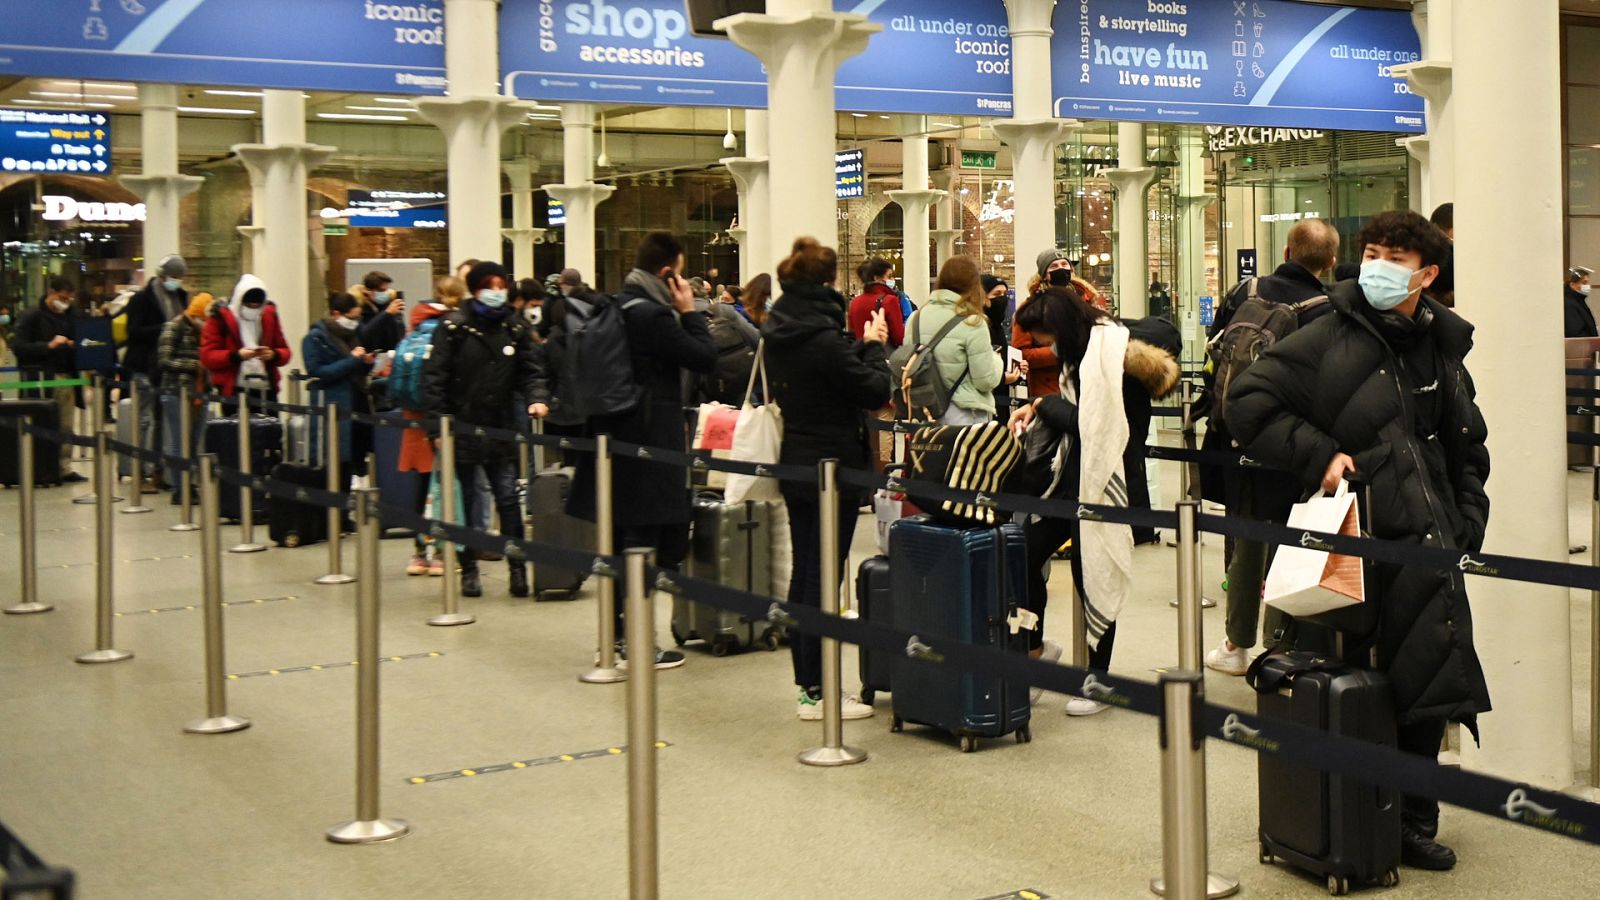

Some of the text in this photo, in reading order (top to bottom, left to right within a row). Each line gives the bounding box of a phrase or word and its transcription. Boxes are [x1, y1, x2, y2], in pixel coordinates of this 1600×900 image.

[364, 0, 443, 23] iconic
[1148, 0, 1187, 15] books
[539, 0, 557, 52] groc
[565, 0, 686, 48] shop
[891, 15, 1009, 38] all under one
[1099, 15, 1187, 36] & storytelling
[394, 26, 444, 45] roof
[580, 45, 705, 67] accessories
[955, 37, 1009, 56] iconic
[1094, 39, 1208, 70] have fun
[1329, 44, 1418, 62] all under one
[976, 59, 1010, 75] roof
[1080, 63, 1090, 84] be
[1119, 70, 1201, 88] live music
[1209, 135, 1226, 151] ice
